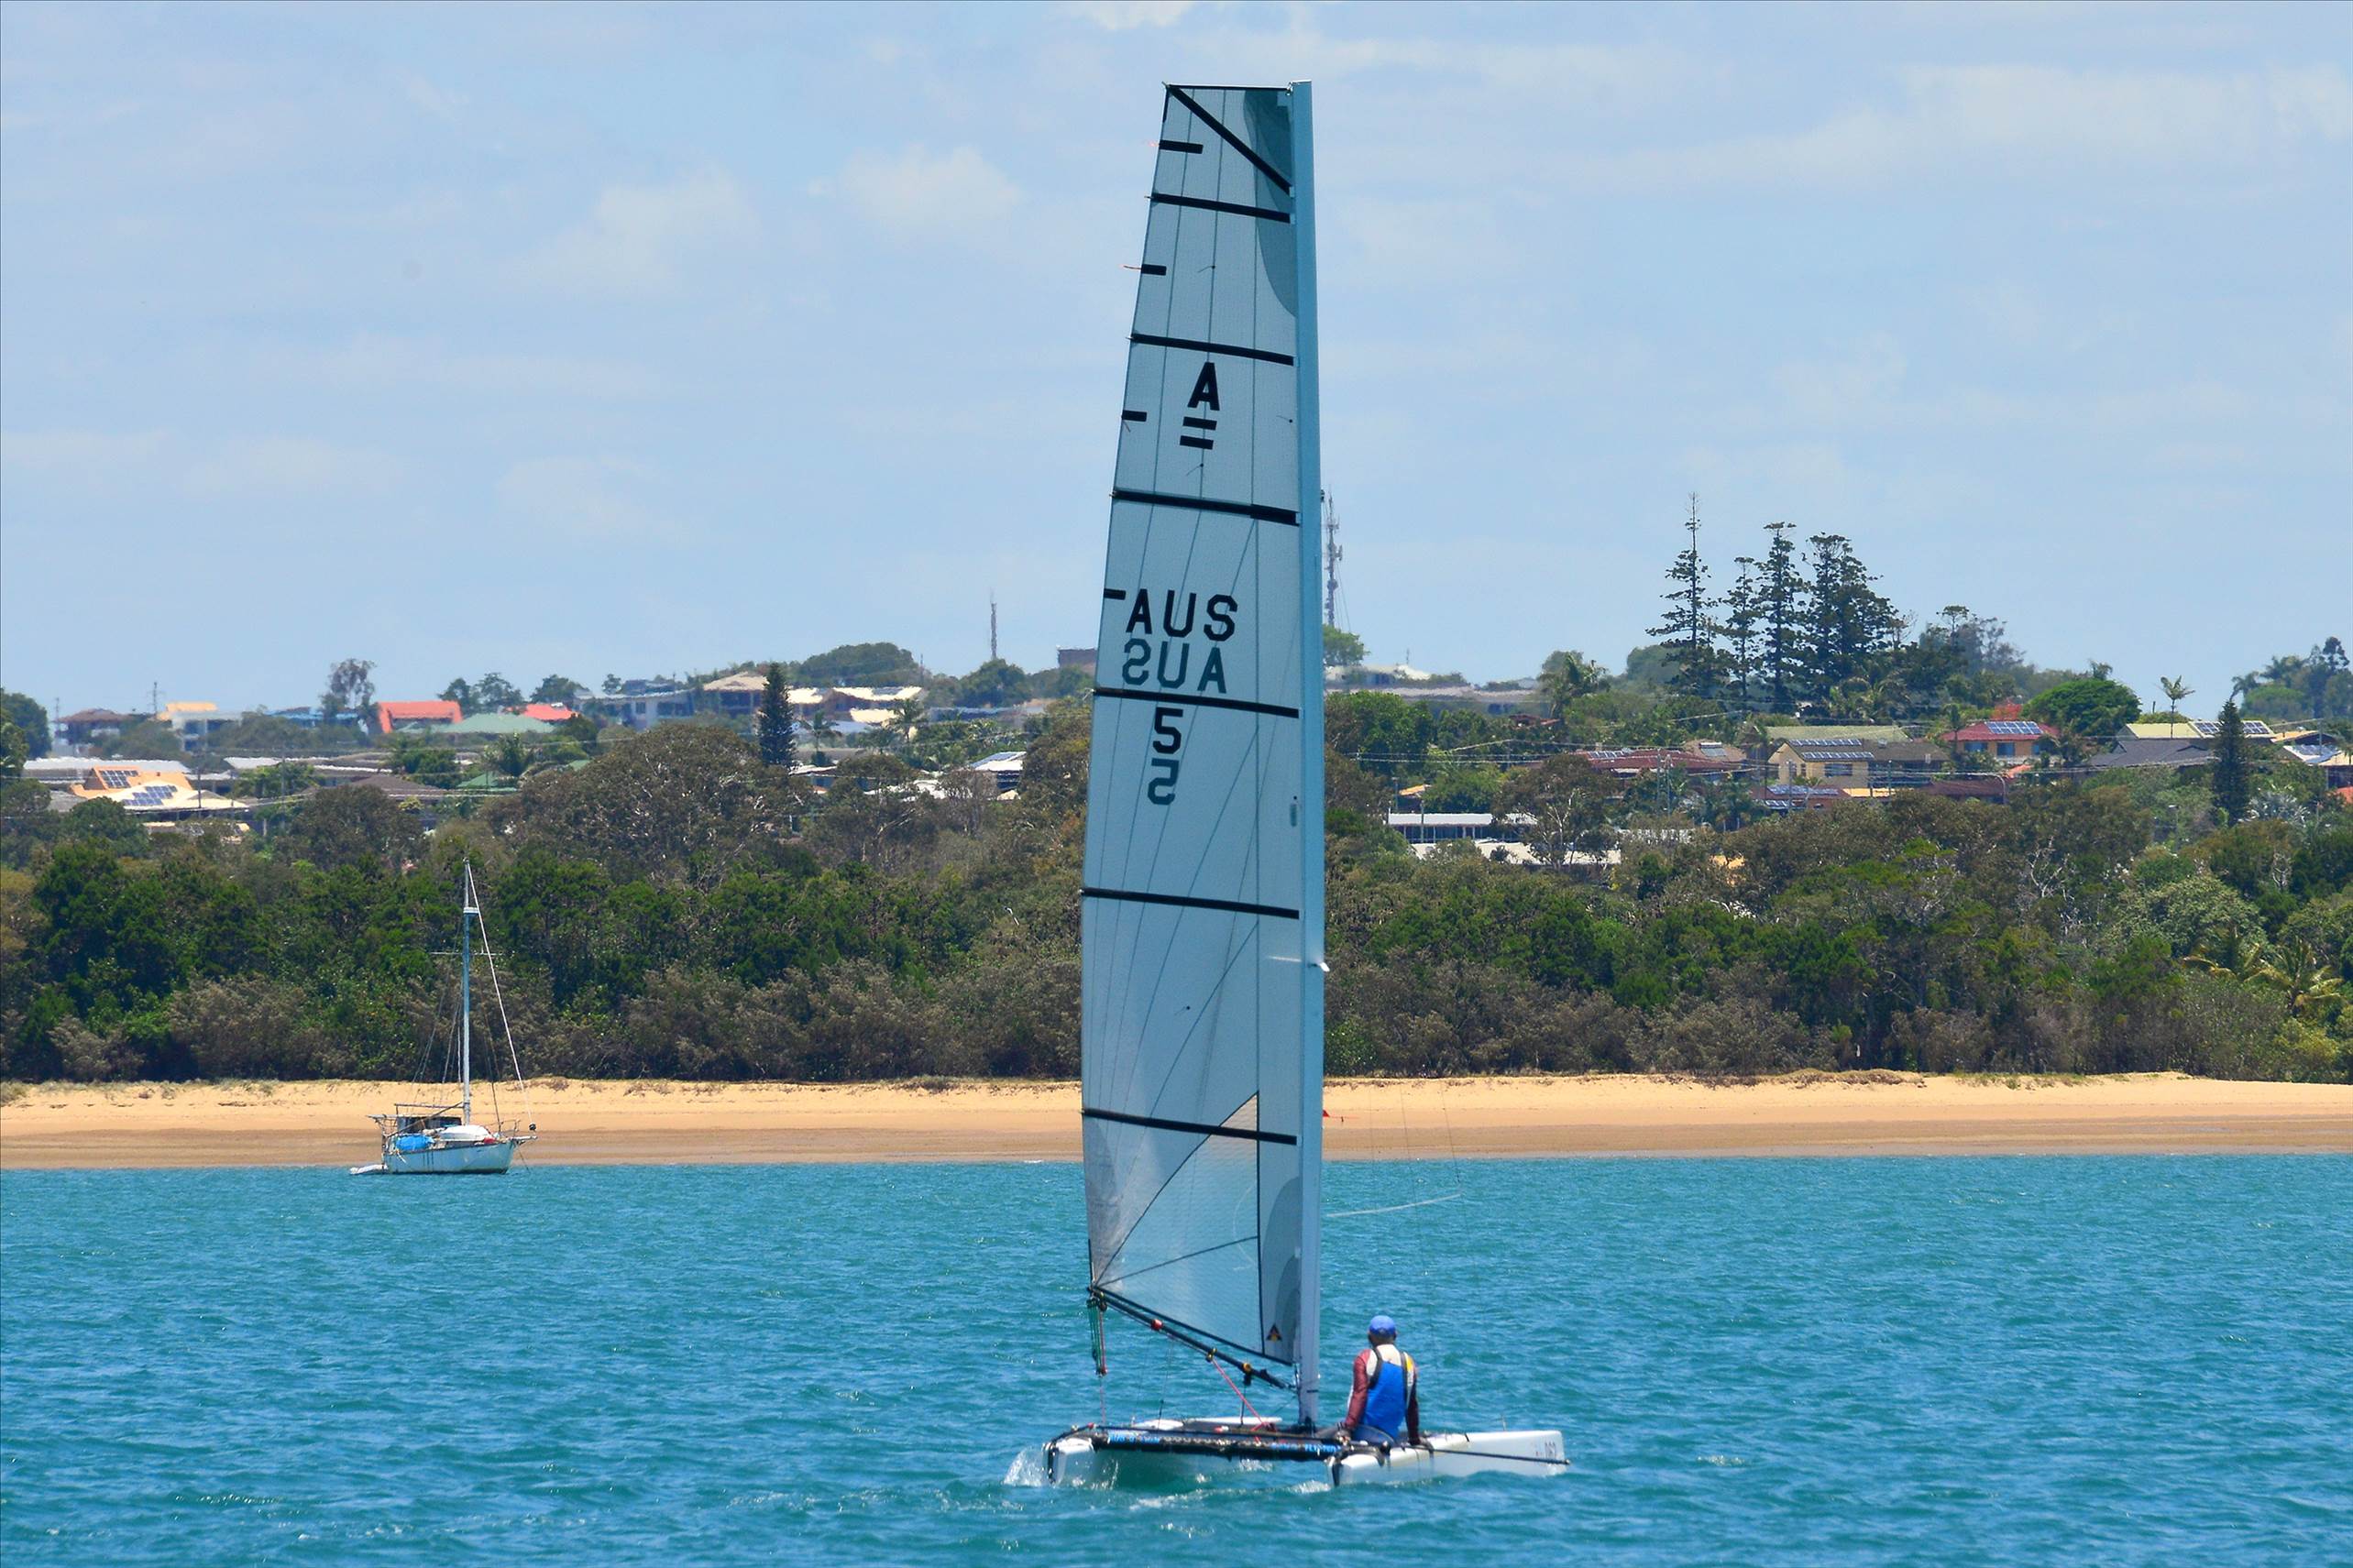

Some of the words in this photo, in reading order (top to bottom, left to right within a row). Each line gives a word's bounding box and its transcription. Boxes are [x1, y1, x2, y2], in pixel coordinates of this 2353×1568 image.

[1187, 361, 1220, 411] A
[1126, 588, 1237, 641] AUS
[1152, 707, 1183, 754] 5
